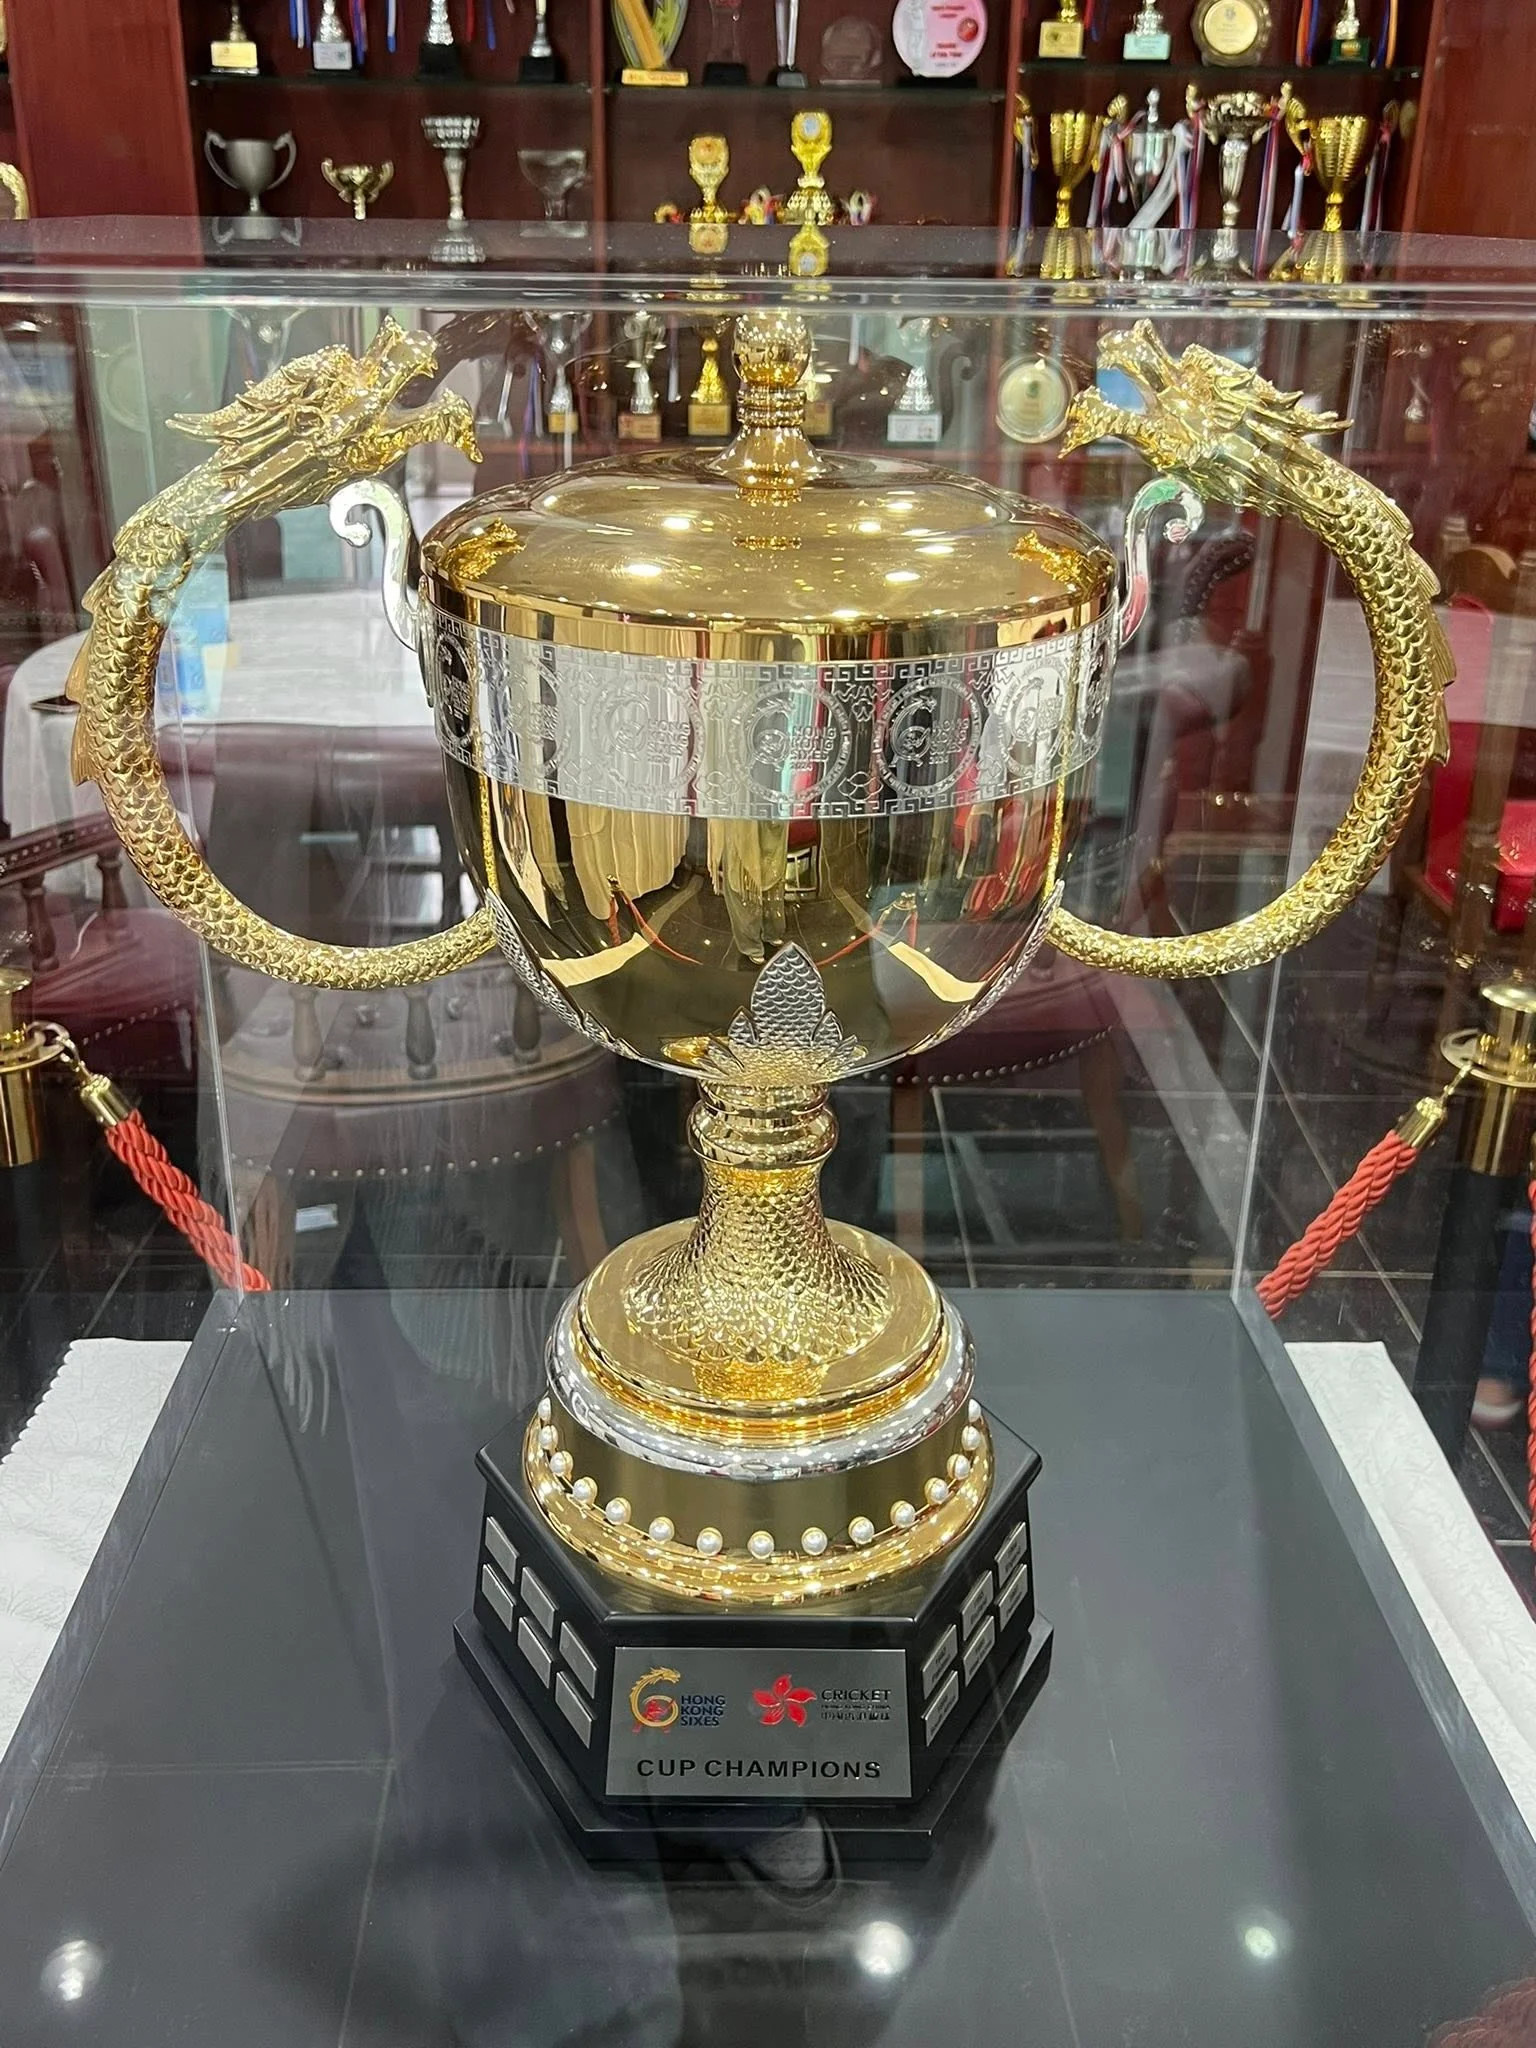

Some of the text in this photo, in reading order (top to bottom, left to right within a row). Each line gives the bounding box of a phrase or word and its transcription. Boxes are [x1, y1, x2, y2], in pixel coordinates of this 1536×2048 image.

[791, 726, 837, 739] HONG
[790, 738, 834, 750] KONG
[681, 1695, 726, 1706] HONG
[821, 1688, 892, 1701] CRICKET
[681, 1705, 724, 1716] KONG
[681, 1715, 720, 1727] SIXES
[636, 1759, 882, 1779] CUP CHAMPIONS
